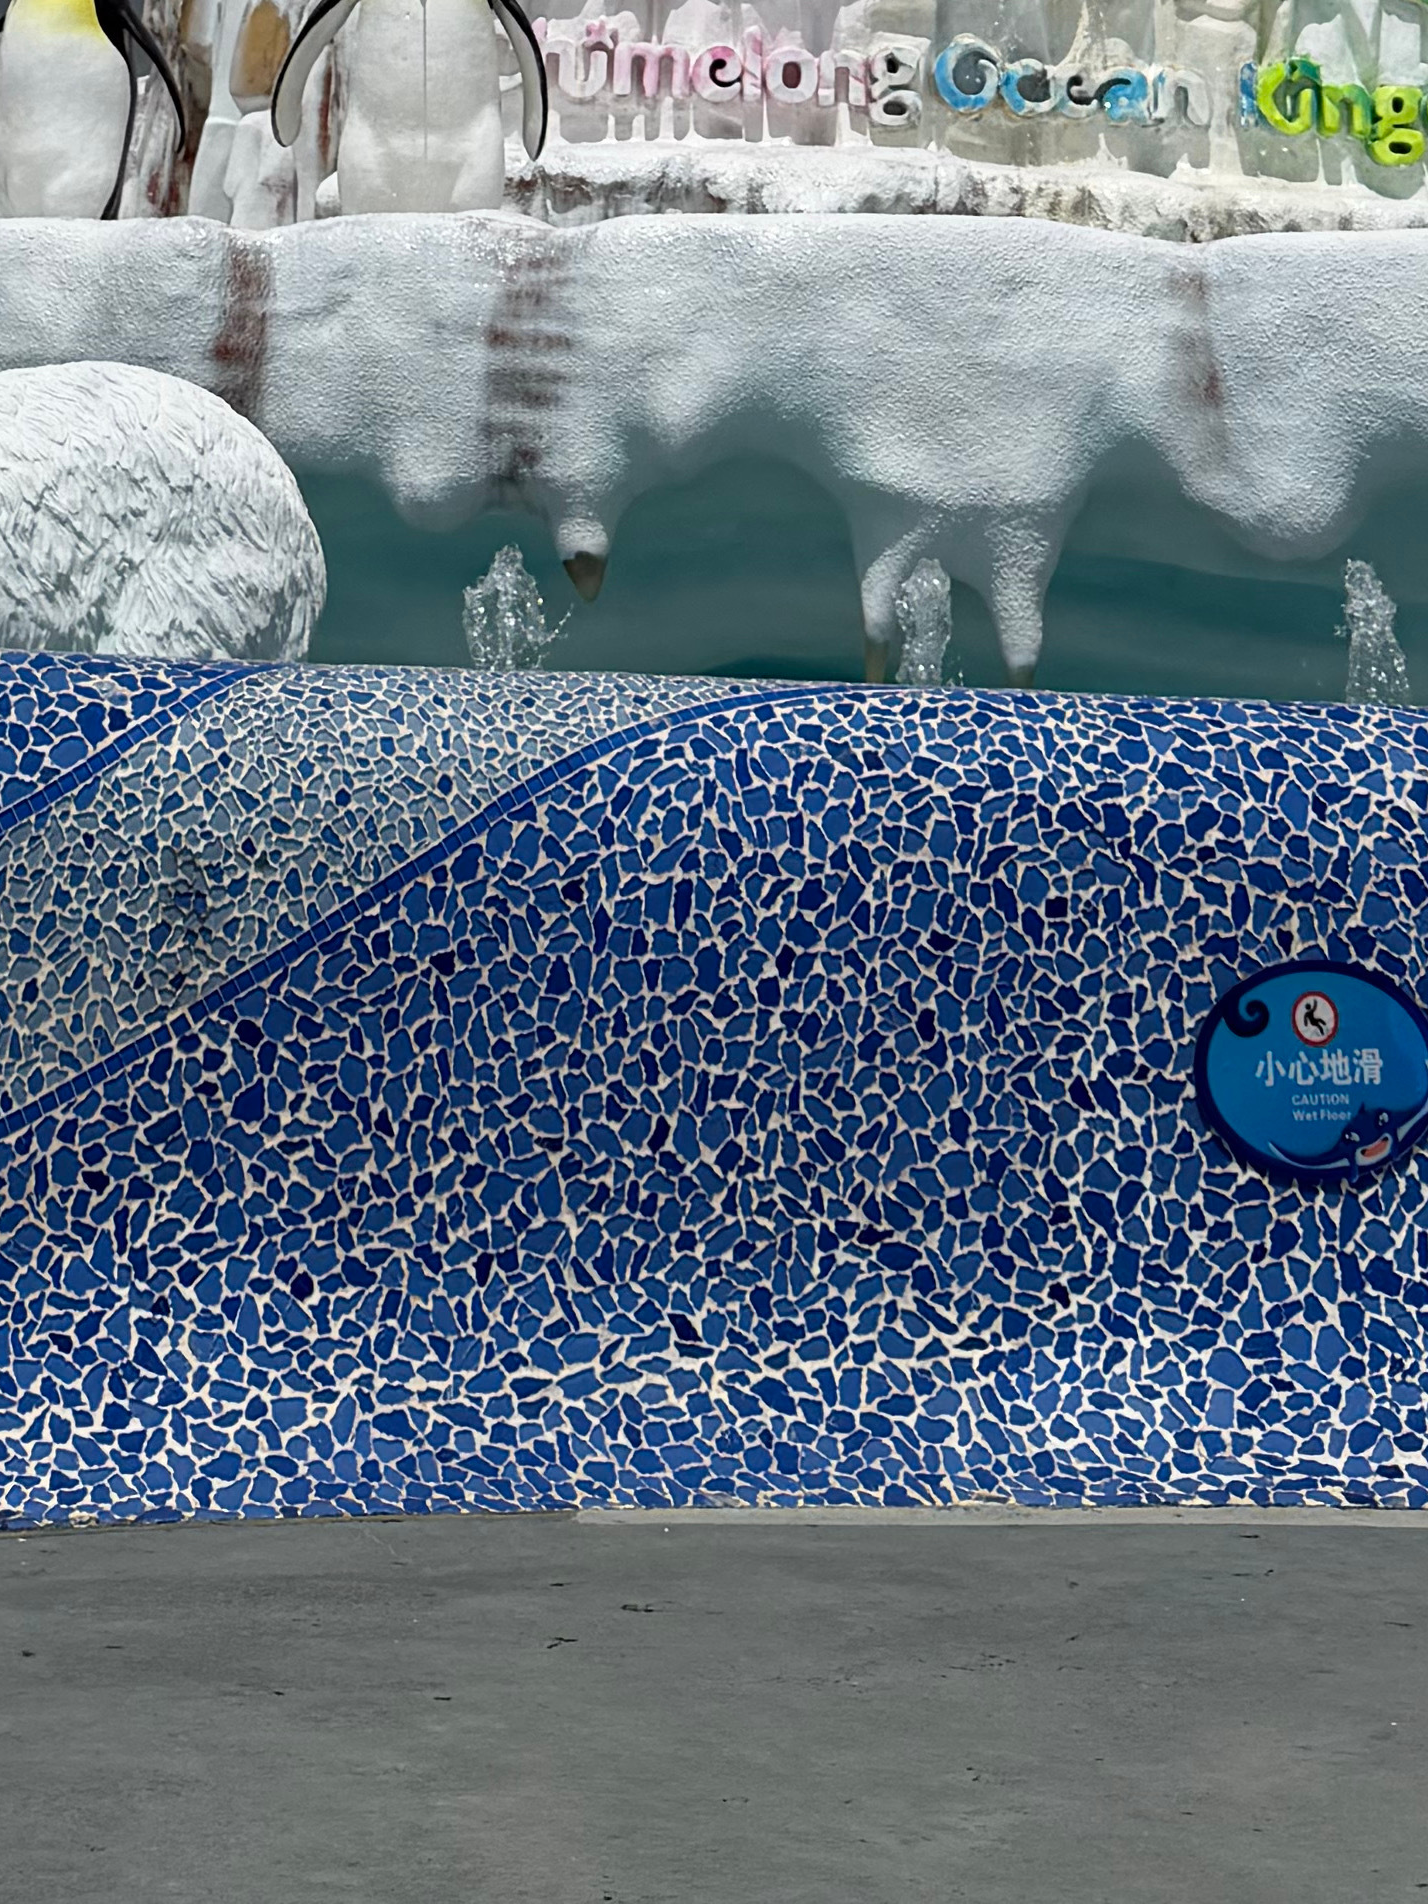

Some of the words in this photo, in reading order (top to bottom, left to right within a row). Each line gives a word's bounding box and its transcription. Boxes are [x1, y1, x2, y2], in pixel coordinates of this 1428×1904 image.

[493, 15, 924, 126] himelong
[933, 33, 1211, 127] Ocean
[1254, 1047, 1384, 1087] 小心地滑
[1291, 1093, 1350, 1106] CAUTION
[1292, 1109, 1318, 1121] Wet
[1320, 1109, 1351, 1121] Floor
